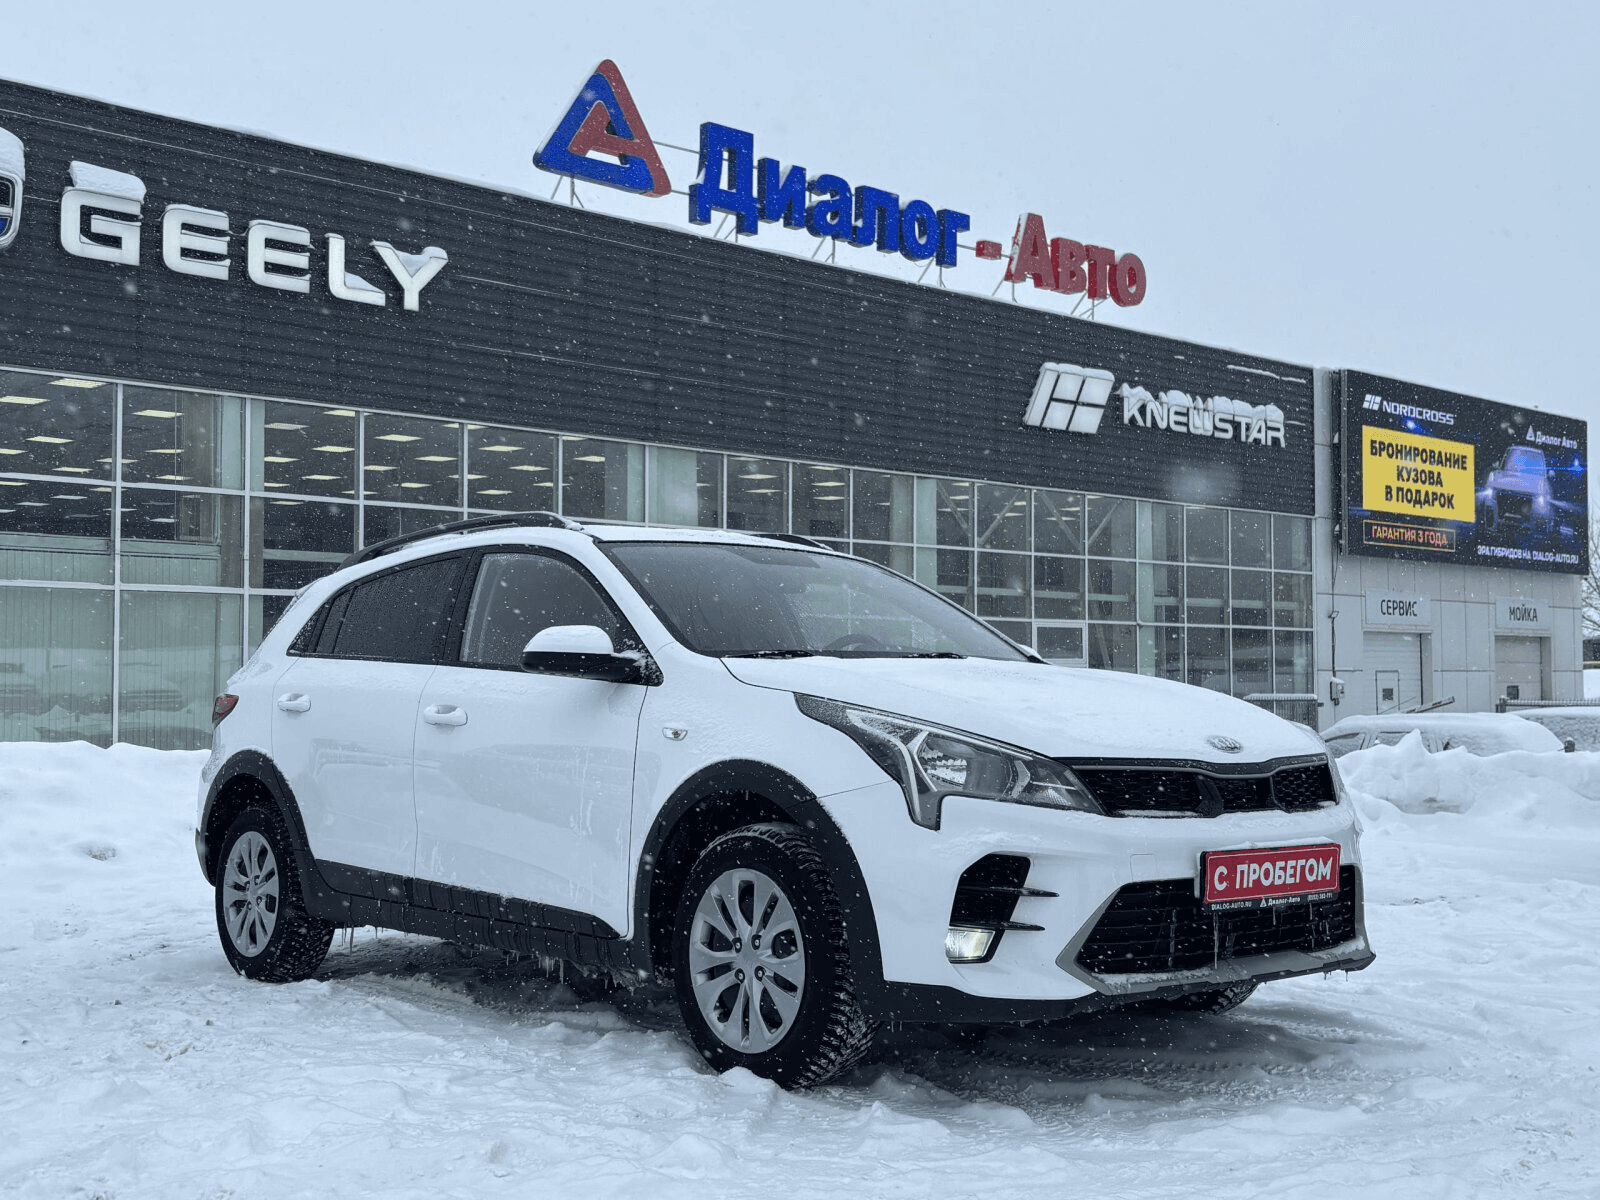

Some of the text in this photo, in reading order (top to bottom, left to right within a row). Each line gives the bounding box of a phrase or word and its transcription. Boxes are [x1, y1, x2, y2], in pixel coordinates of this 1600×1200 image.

[688, 121, 1147, 307] Диалог-Авто
[60, 185, 449, 312] GEELY
[1123, 395, 1286, 448] KNEWSTAR
[1382, 400, 1455, 426] NORDCROSS
[1370, 439, 1468, 472] БРОНИРОВАНИЕ
[1396, 465, 1443, 488] КУЗОВА
[1385, 485, 1455, 510] В ПОДАРОК
[1371, 525, 1448, 547] ГАРАНТИЯ 3 ГОДА
[1380, 598, 1418, 618] СЕРВИС
[1508, 603, 1538, 623] МОЙКА
[1213, 856, 1333, 891] С ПРОБЕГОМ
